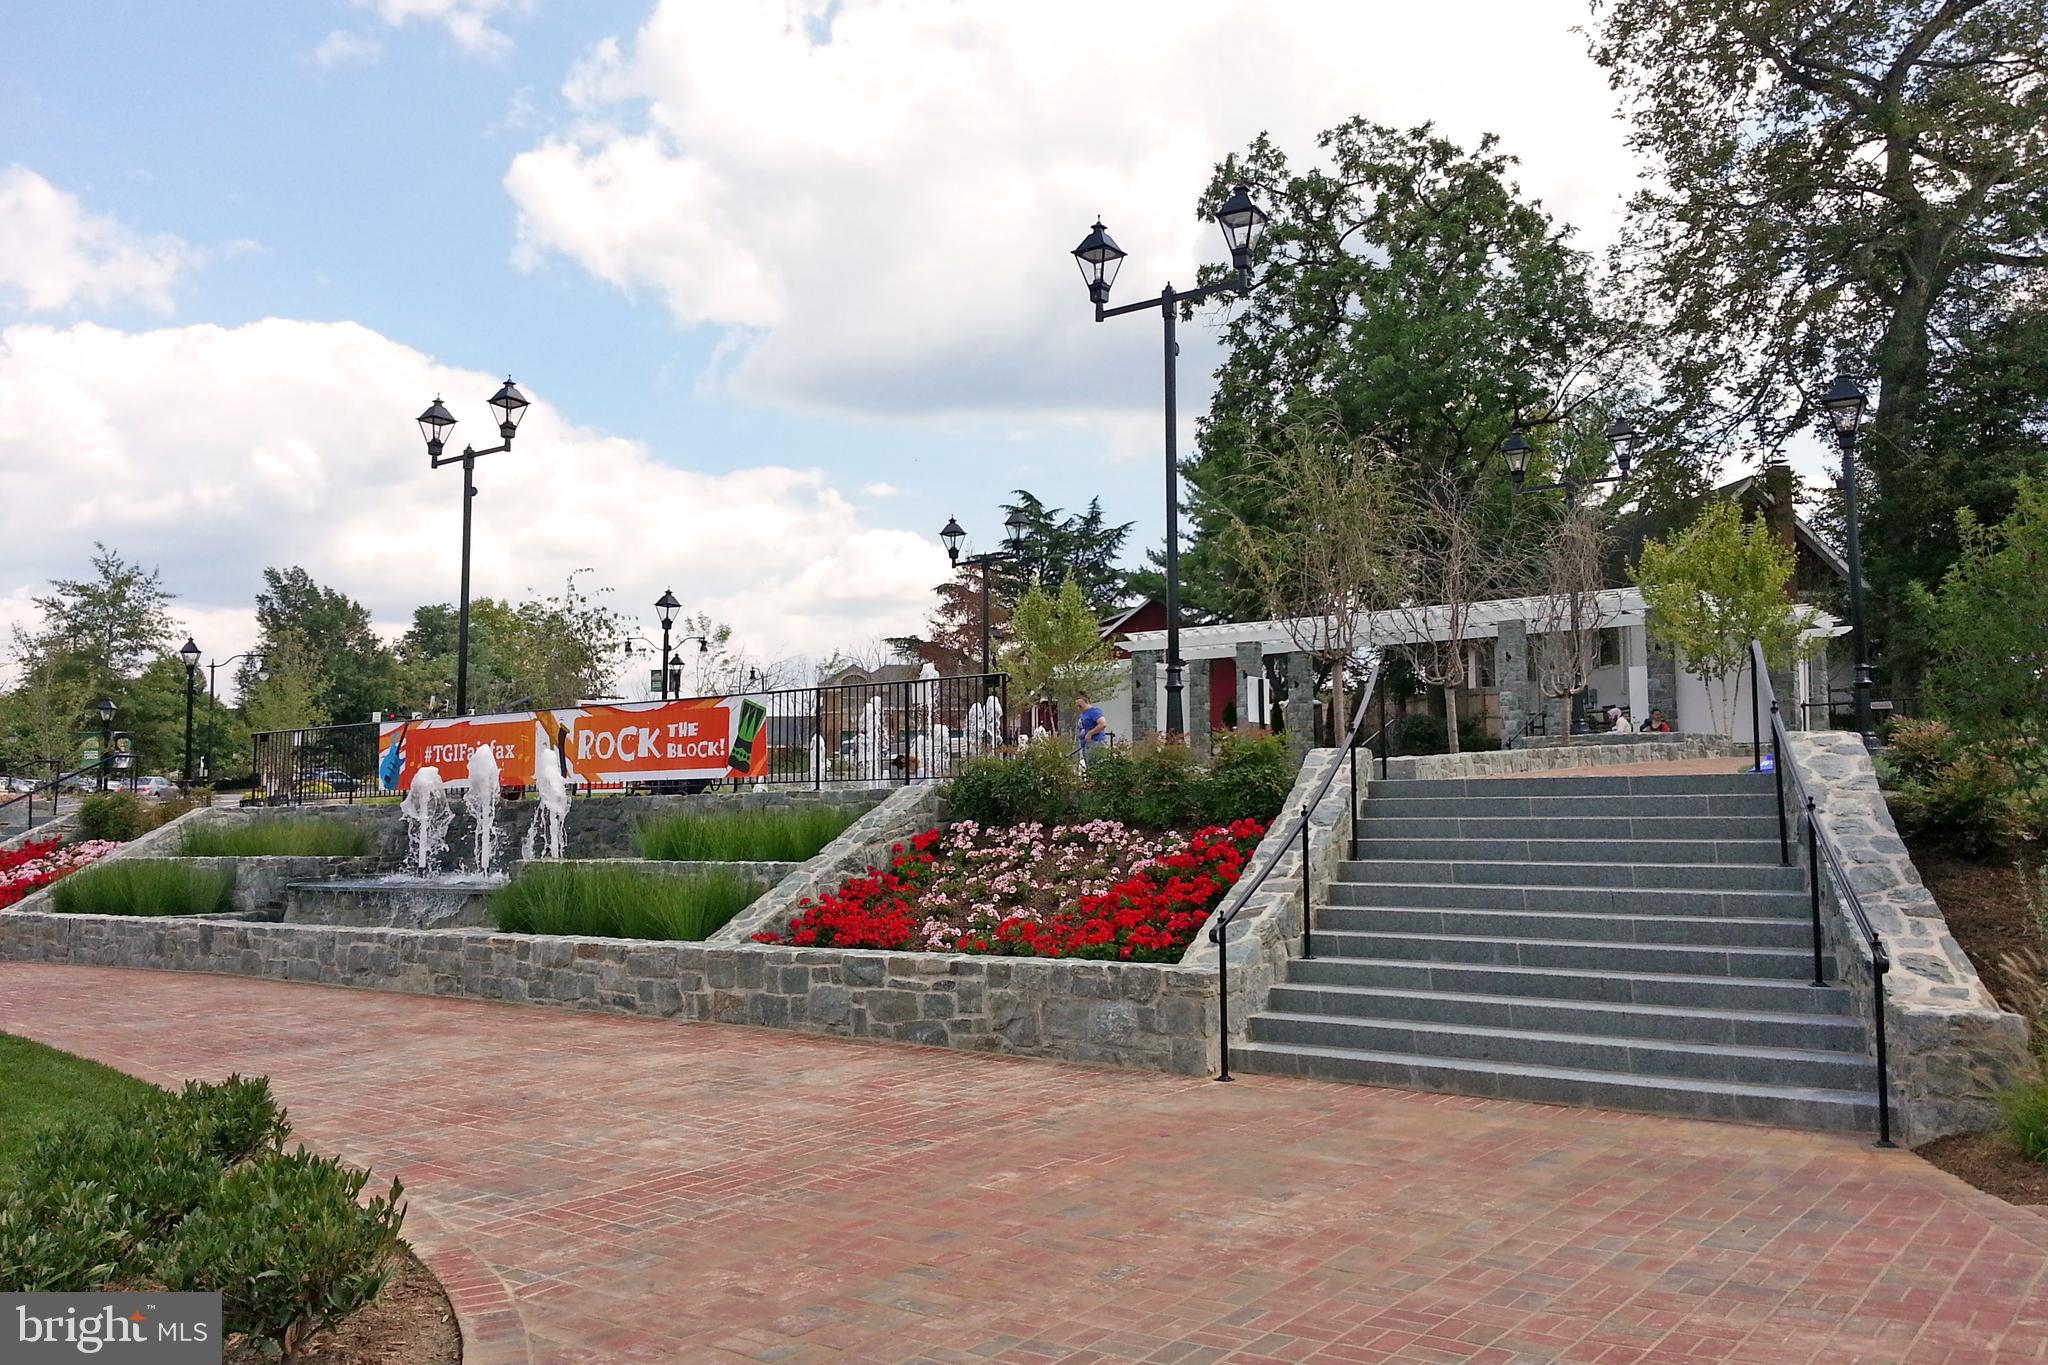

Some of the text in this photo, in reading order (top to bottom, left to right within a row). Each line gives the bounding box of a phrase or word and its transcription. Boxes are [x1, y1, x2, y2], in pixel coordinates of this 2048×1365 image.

[667, 721, 699, 738] THE
[424, 739, 515, 764] #TGIFafax
[578, 726, 662, 761] ROCK
[666, 738, 725, 758] BLOCK!
